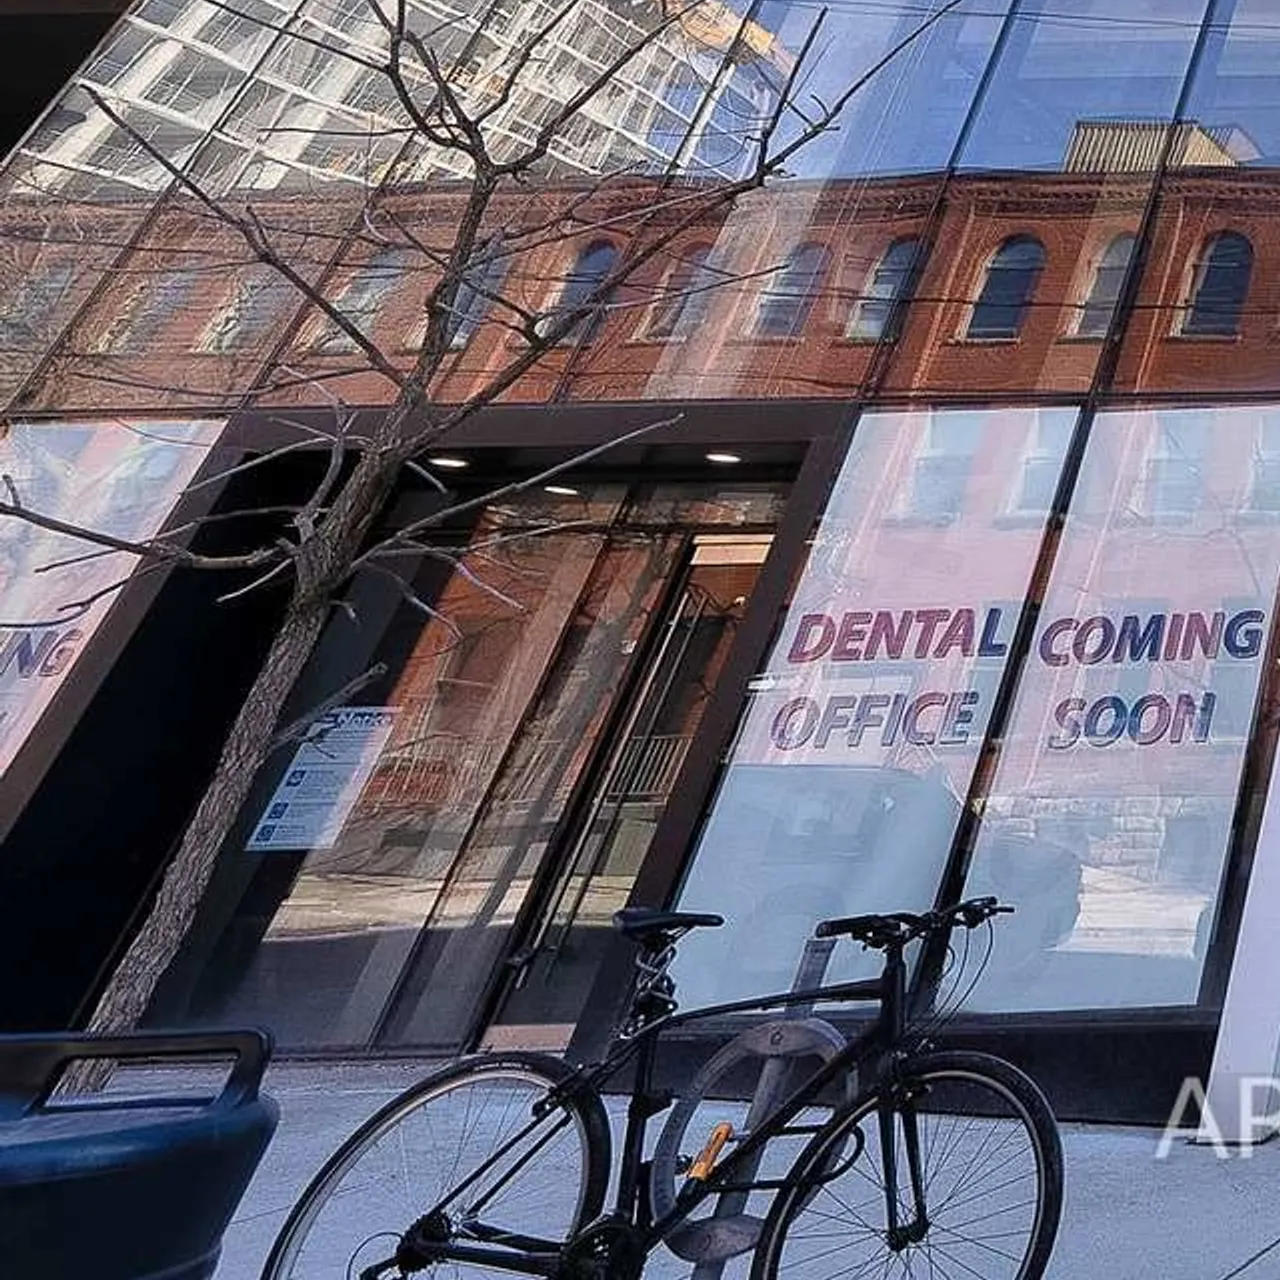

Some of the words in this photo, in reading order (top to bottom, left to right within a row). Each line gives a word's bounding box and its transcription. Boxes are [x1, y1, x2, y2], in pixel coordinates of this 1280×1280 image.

[787, 608, 1008, 664] DENTAL
[1039, 610, 1265, 667] COMING
[771, 691, 980, 751] OFFICE
[1047, 692, 1217, 749] SOON
